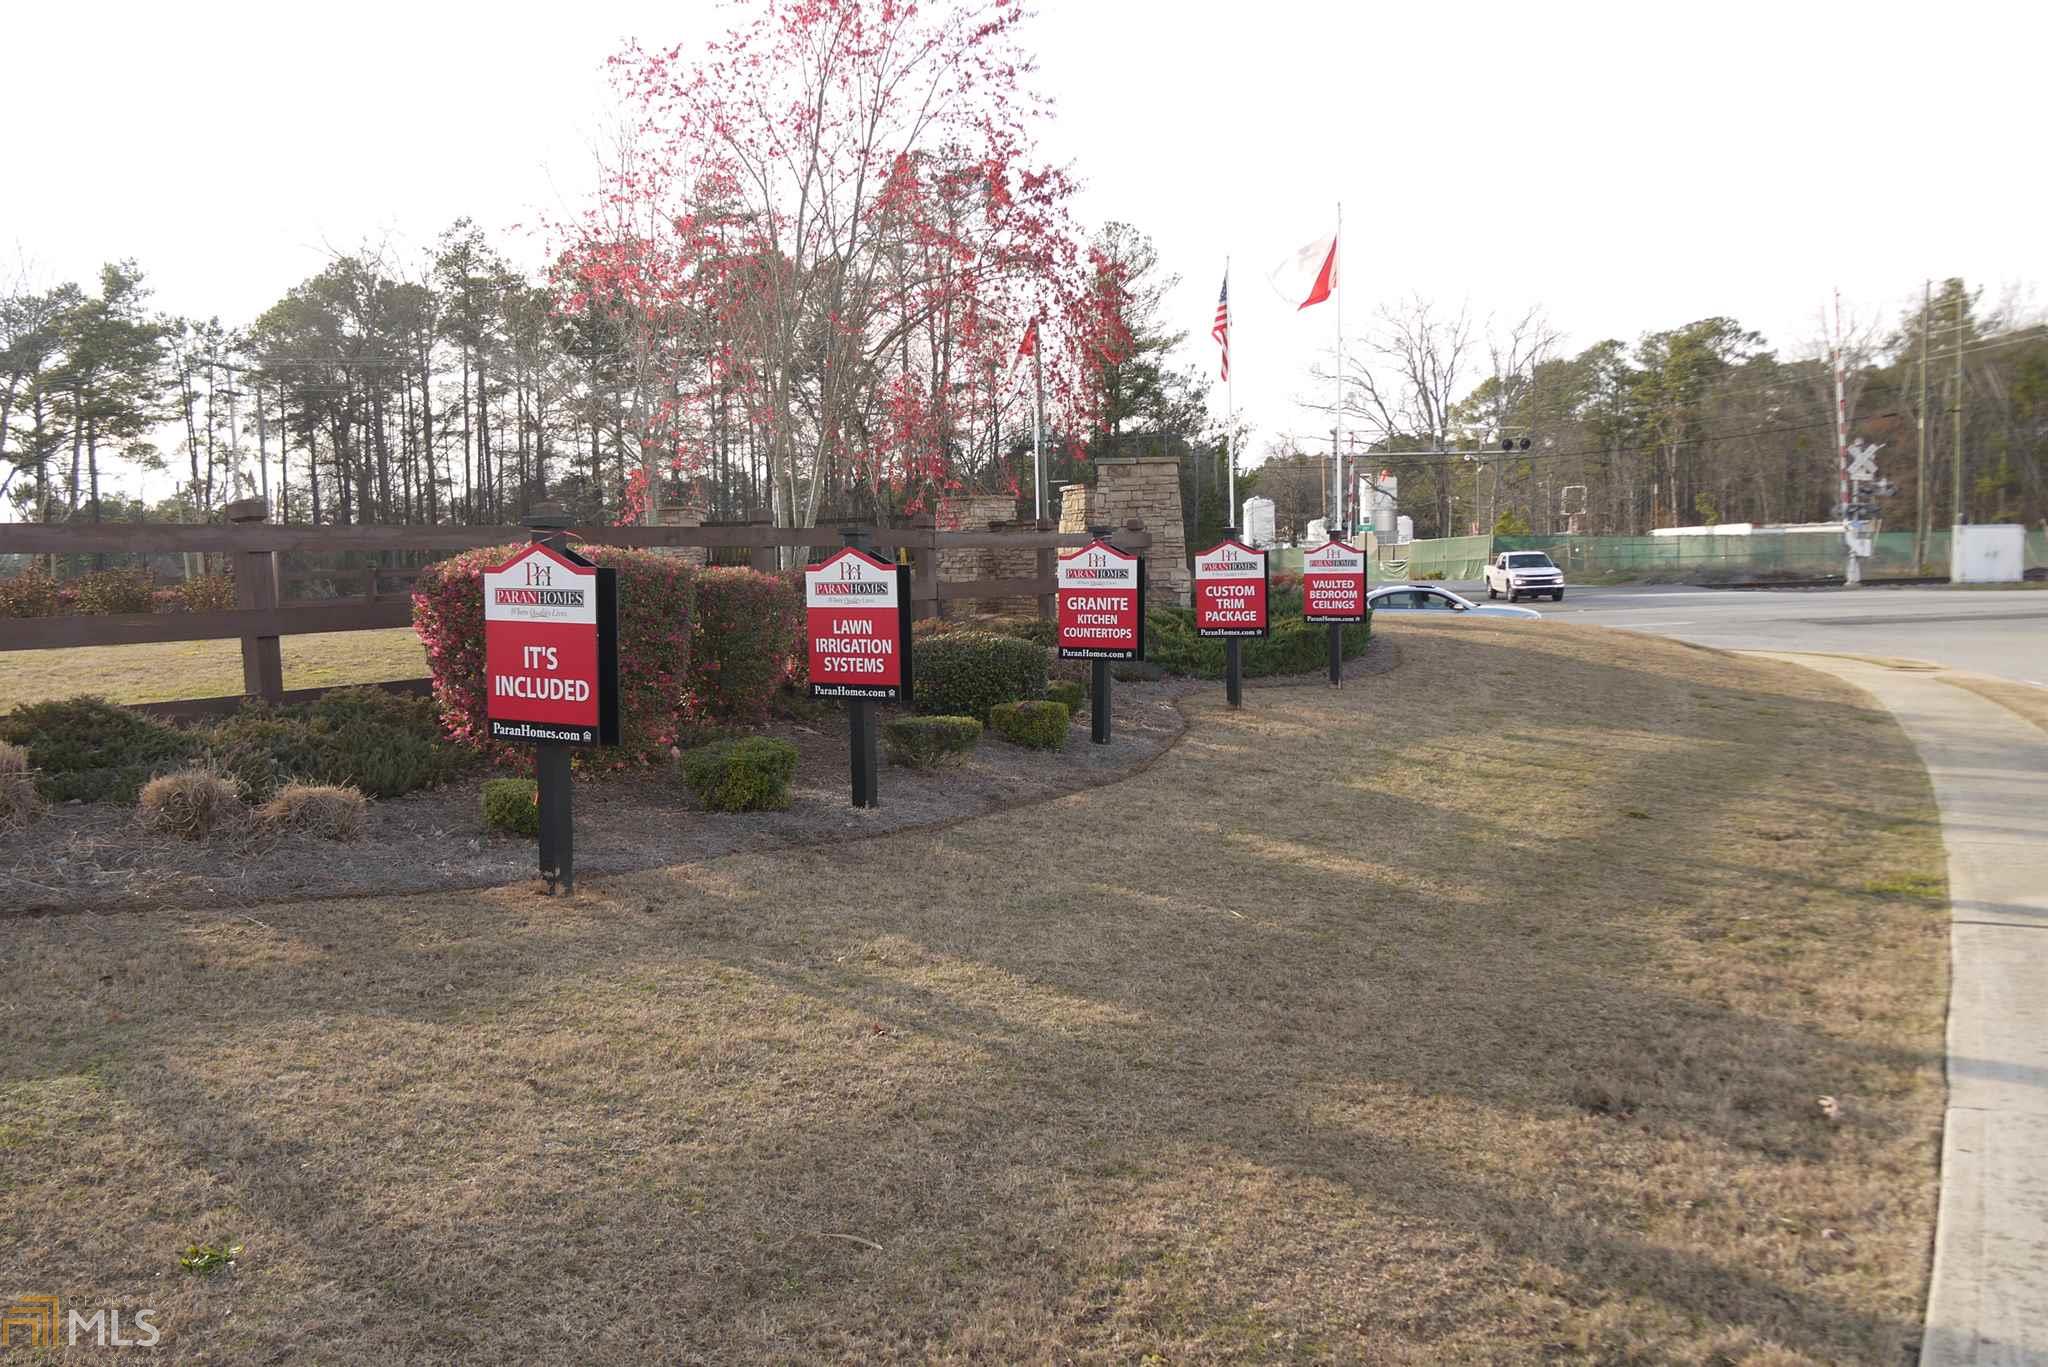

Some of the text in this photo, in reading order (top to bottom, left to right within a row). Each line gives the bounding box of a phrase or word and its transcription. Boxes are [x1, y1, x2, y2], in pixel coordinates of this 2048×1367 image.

[1312, 580, 1355, 589] VAULTED
[1205, 585, 1256, 597] CUSTOM
[1309, 590, 1358, 599] BEDROOM
[496, 590, 584, 605] PARANHOMES
[1215, 598, 1245, 609] TRIM
[1067, 597, 1129, 611] GRANITE
[1312, 600, 1355, 609] CEILINGS
[1077, 614, 1118, 625] KITCHEN
[1205, 610, 1257, 622] PACKAGE
[833, 619, 872, 634] LAWN
[1063, 627, 1132, 639] COUNTERTOPS
[815, 638, 892, 654] IRRIGATION
[524, 646, 558, 670] IT'S
[1062, 648, 1125, 658] ParanHomes.com
[824, 656, 884, 672] SYSTEMS
[495, 675, 590, 702] INCLUDED
[814, 684, 886, 697] ParanHomes.com
[493, 722, 580, 741] ParanHomes.com
